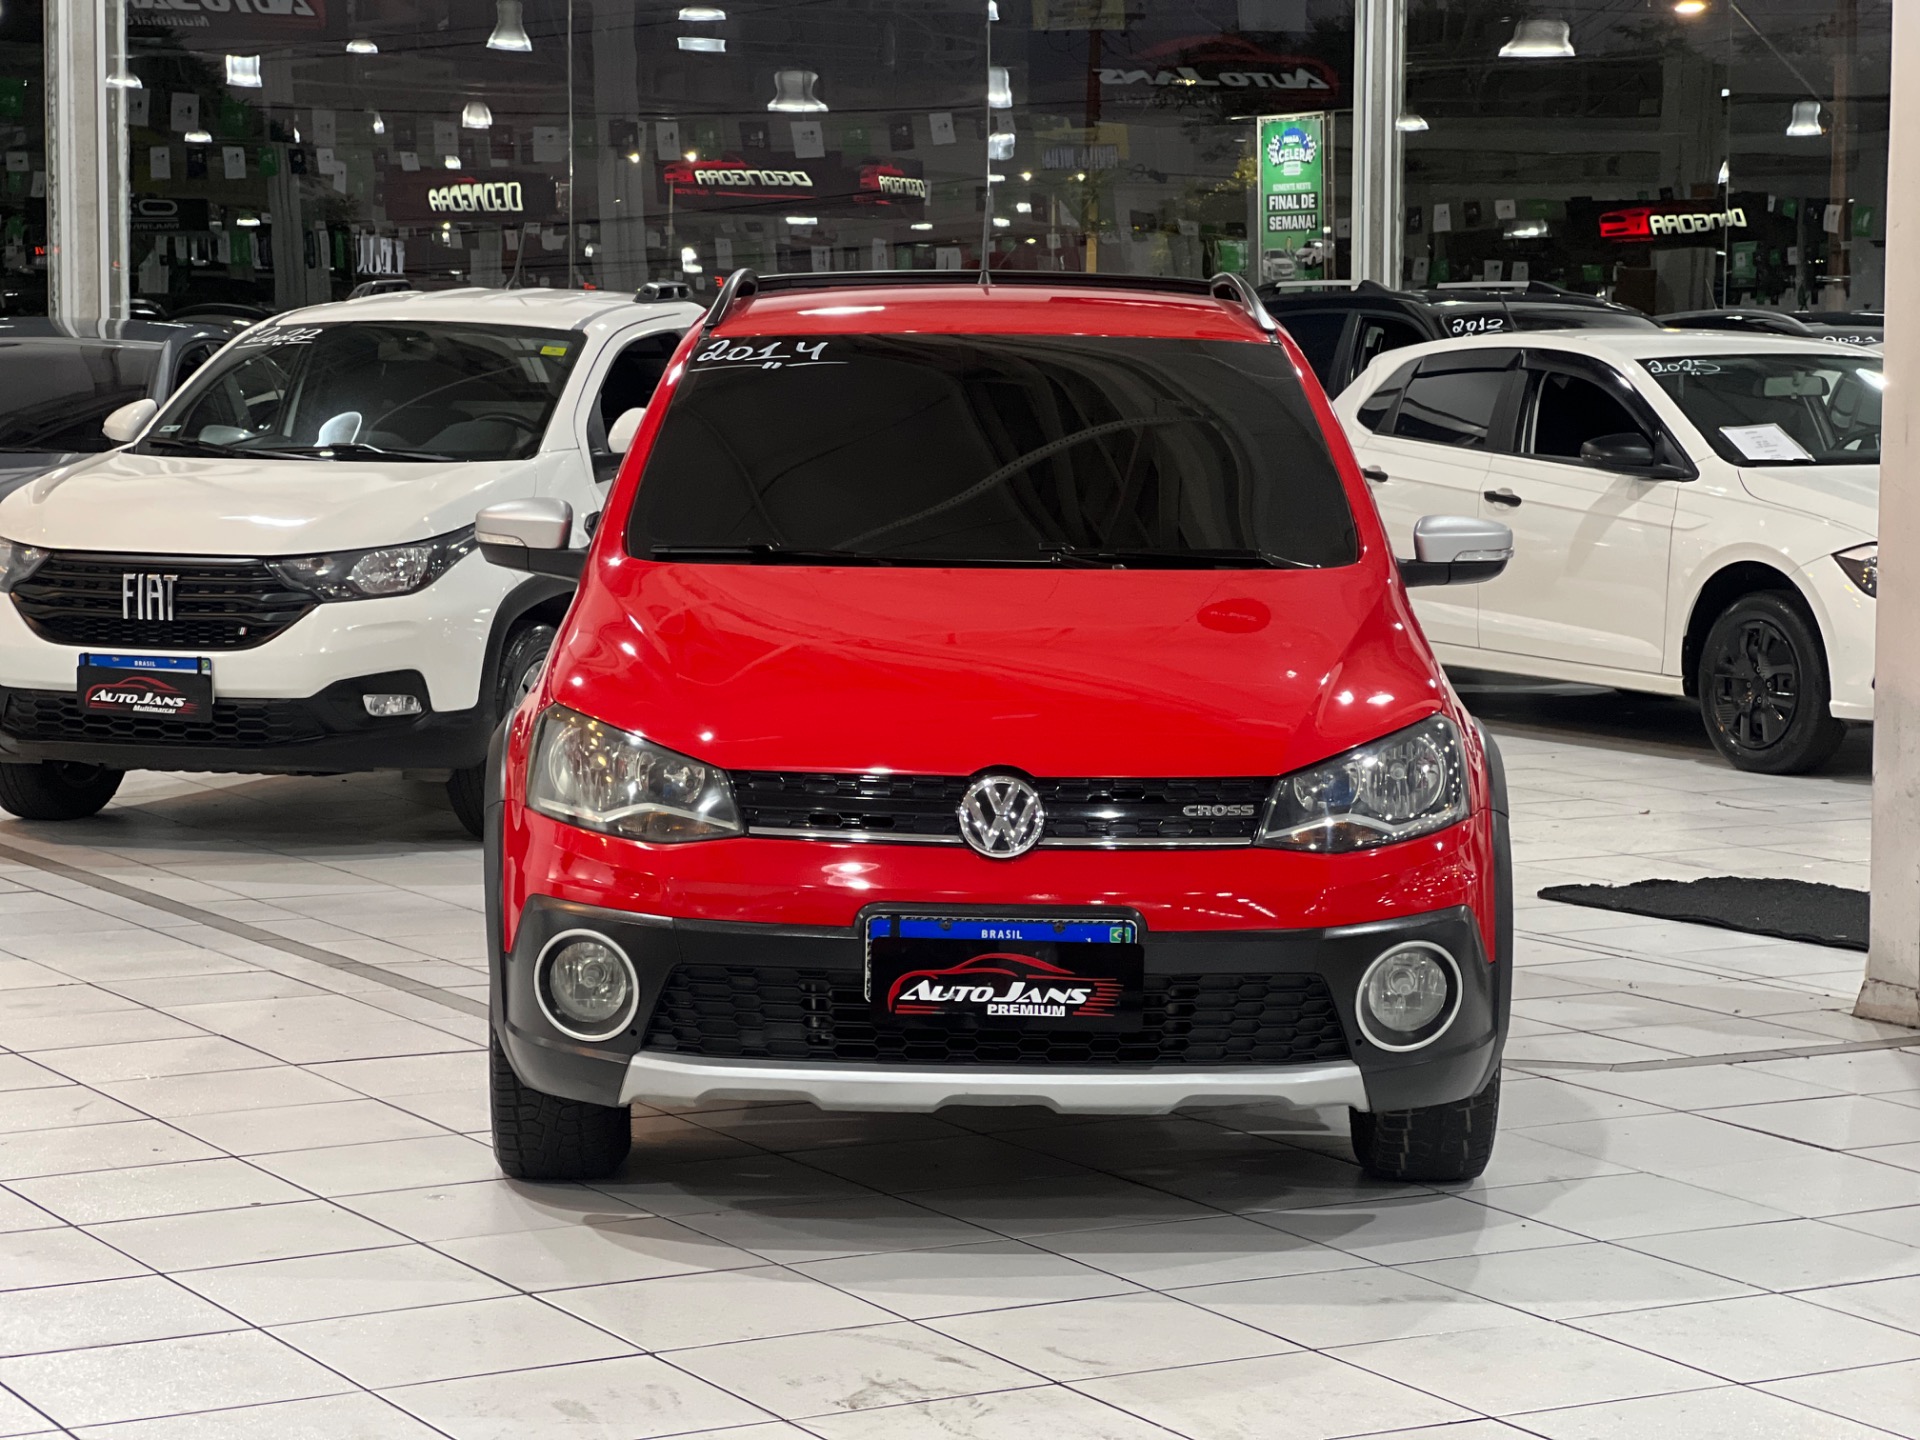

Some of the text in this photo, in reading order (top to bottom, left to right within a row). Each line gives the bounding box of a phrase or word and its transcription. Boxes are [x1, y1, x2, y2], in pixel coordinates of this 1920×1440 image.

[1269, 194, 1315, 210] FINAL DE
[1269, 215, 1316, 230] SEMANA!
[1452, 316, 1504, 334] 2012
[697, 339, 829, 362] 2014
[122, 573, 179, 621] FIAT
[133, 704, 176, 714] Multimarcas
[1183, 804, 1255, 817] CROSS
[981, 928, 1023, 940] BRASIL
[987, 1004, 1066, 1017] PREMIUM
